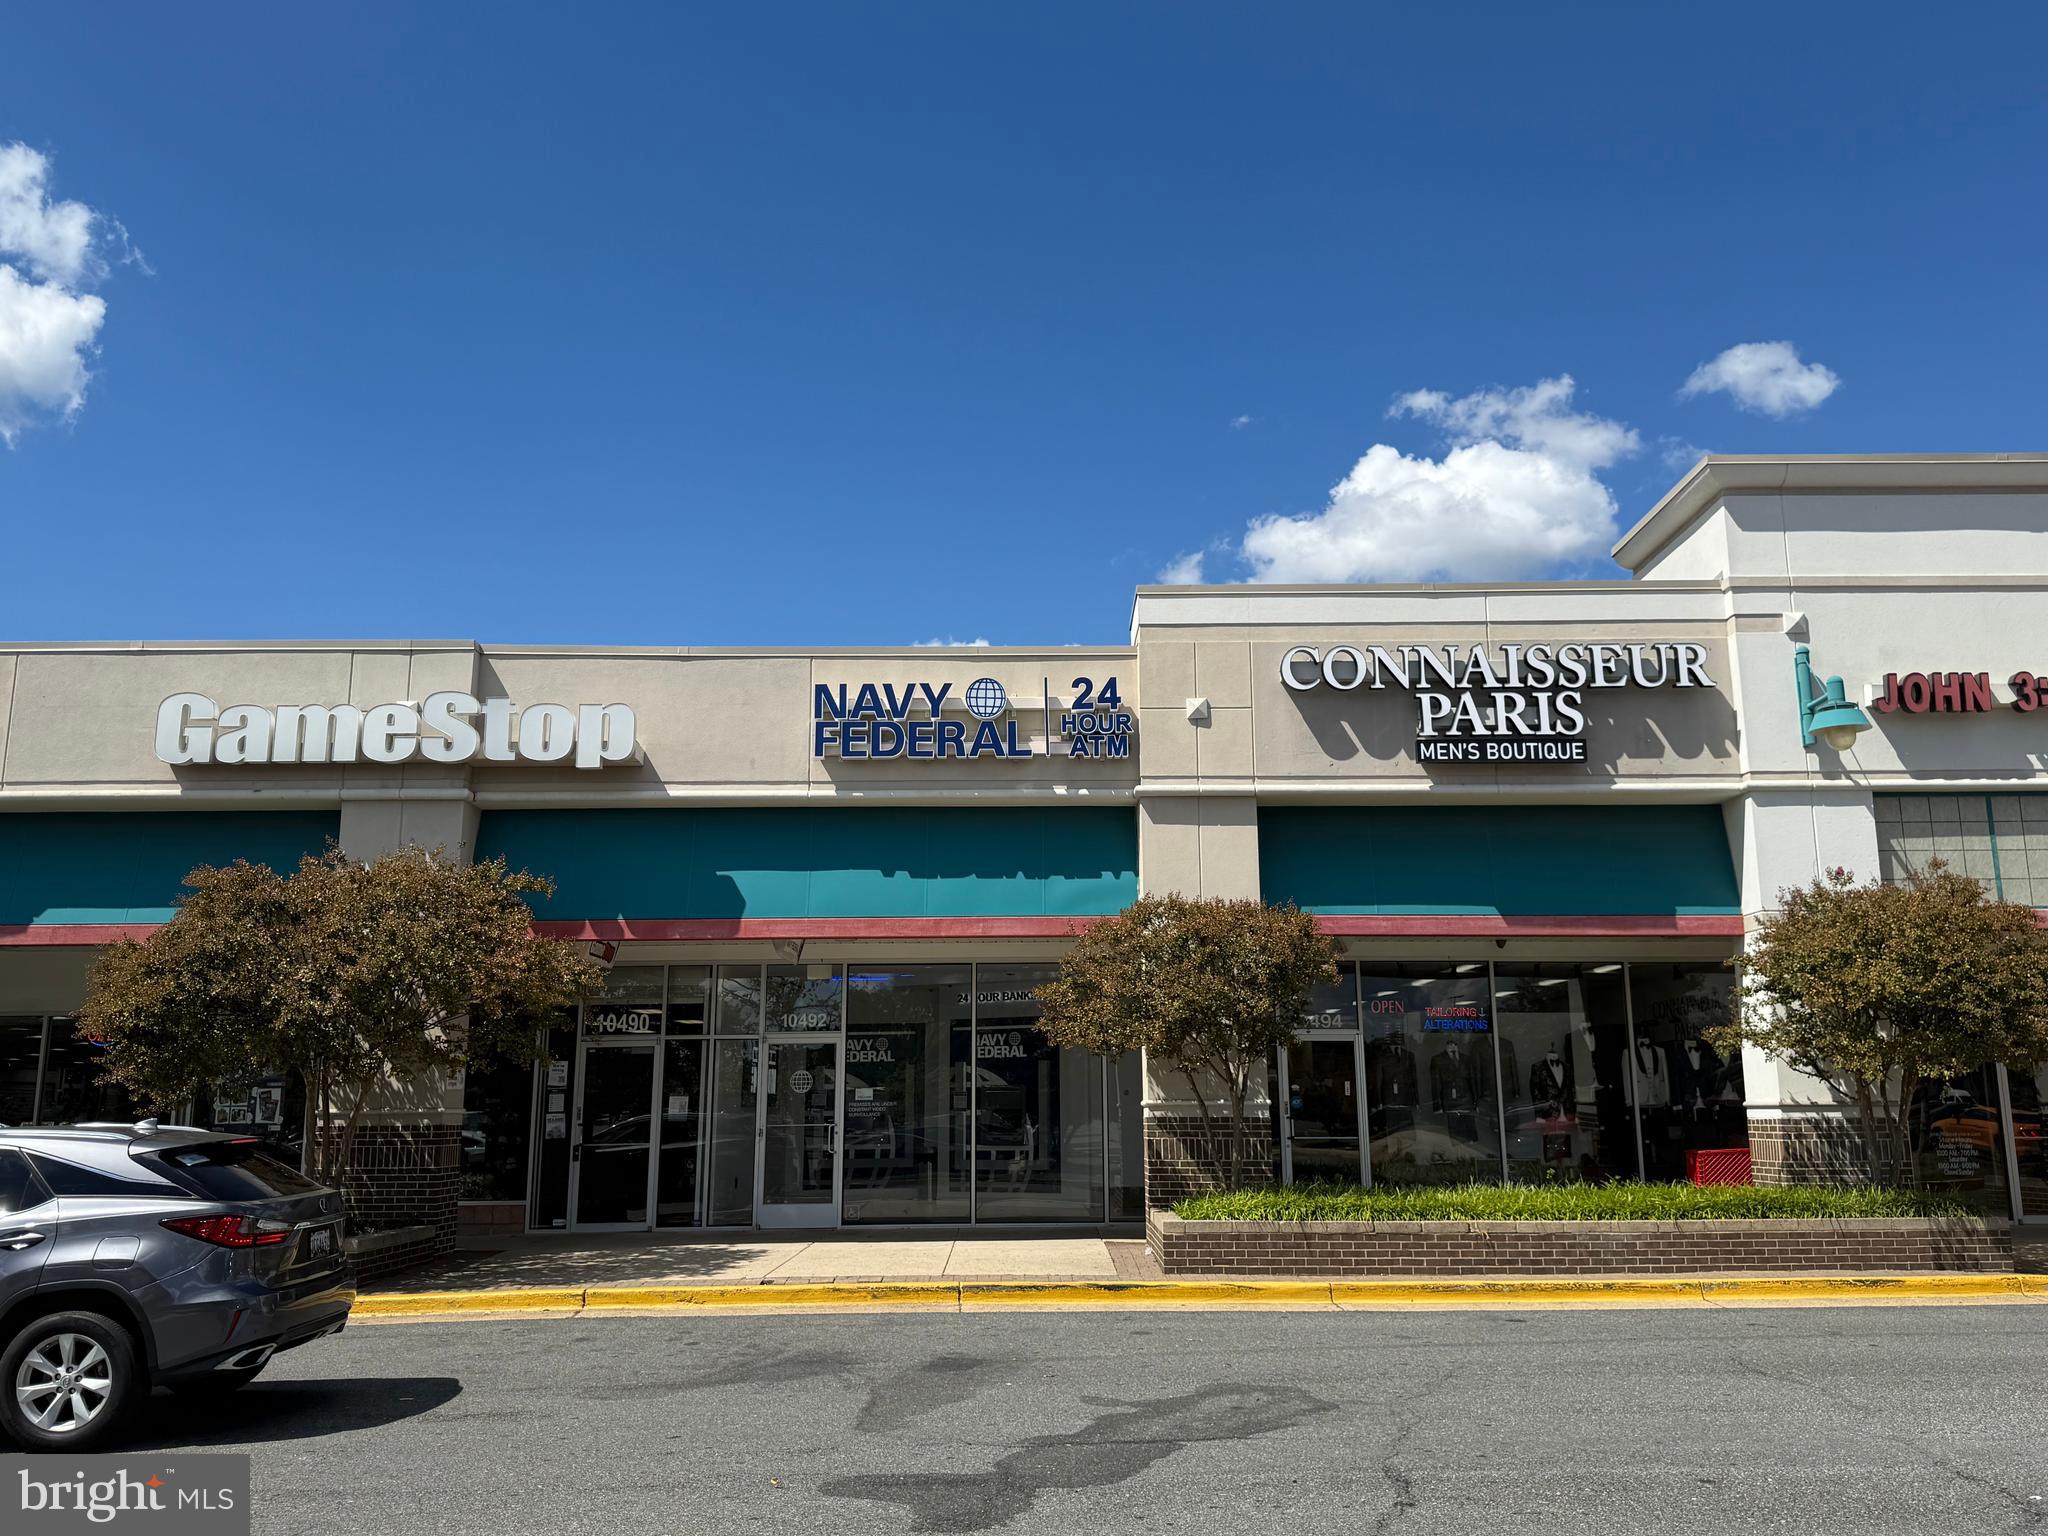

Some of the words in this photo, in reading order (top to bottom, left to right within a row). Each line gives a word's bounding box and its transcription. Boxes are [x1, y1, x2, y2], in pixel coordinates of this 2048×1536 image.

[1281, 642, 1718, 691] CONNAISSEUR
[815, 683, 953, 720] NAVY
[1071, 676, 1122, 711] 24
[1876, 671, 1993, 713] JOHN
[1415, 689, 1587, 738] PARIS
[154, 690, 638, 769] GameStop
[1061, 713, 1134, 735] HOUR
[815, 720, 1033, 759] FEDERAL
[1069, 735, 1129, 759] ATM
[1418, 741, 1481, 761] MEN'S
[1486, 741, 1586, 761] BOUTIQUE
[957, 993, 969, 1003] 24
[976, 992, 1000, 1002] OUR
[1371, 999, 1405, 1014] OPEN
[781, 1013, 827, 1028] 10492
[1306, 1013, 1343, 1028] 494
[1425, 1007, 1477, 1017] TAILORING
[597, 1013, 650, 1033] 10490
[1424, 1019, 1489, 1030] ALTERATIONS
[846, 1039, 874, 1051] AVY
[976, 1033, 1007, 1046] AVY
[846, 1050, 896, 1063] DERAL
[976, 1045, 1028, 1059] EDERAL
